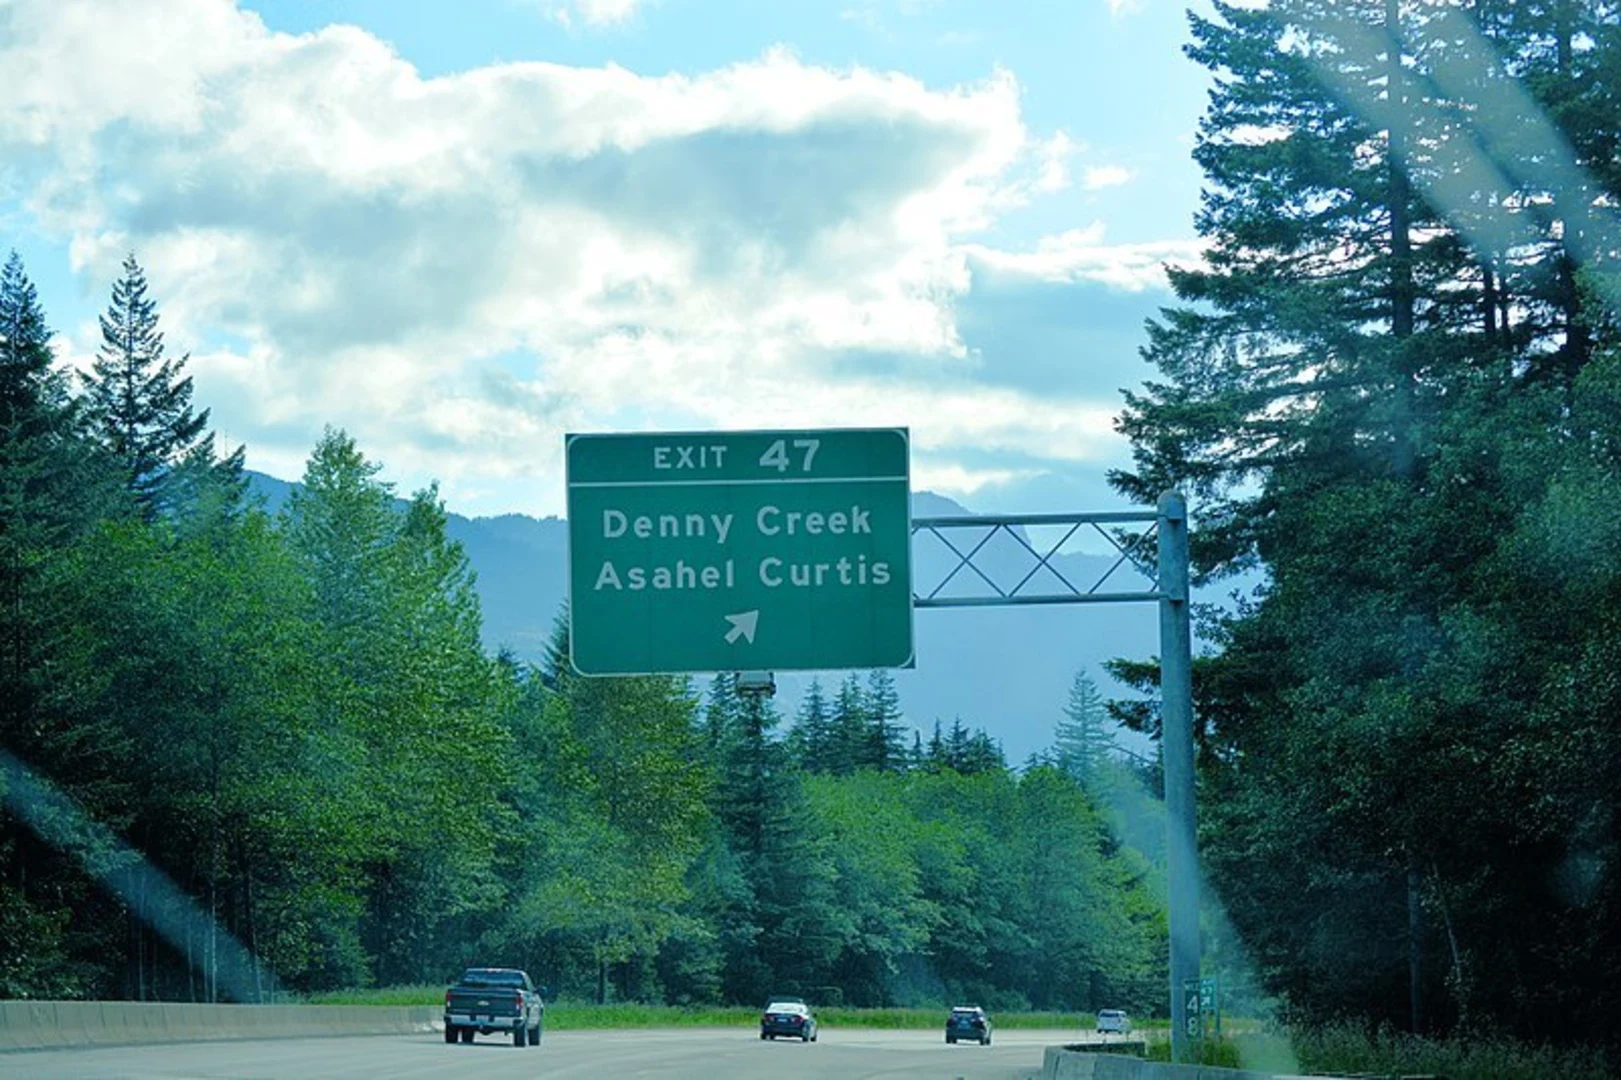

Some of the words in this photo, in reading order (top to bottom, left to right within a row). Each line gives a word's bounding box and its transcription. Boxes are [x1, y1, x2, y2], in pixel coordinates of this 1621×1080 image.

[654, 445, 728, 469] EXIT
[759, 439, 820, 472] 47
[603, 508, 734, 544] Denny
[756, 505, 872, 535] Creek
[594, 559, 735, 591] Asahel
[759, 554, 891, 587] Curtis
